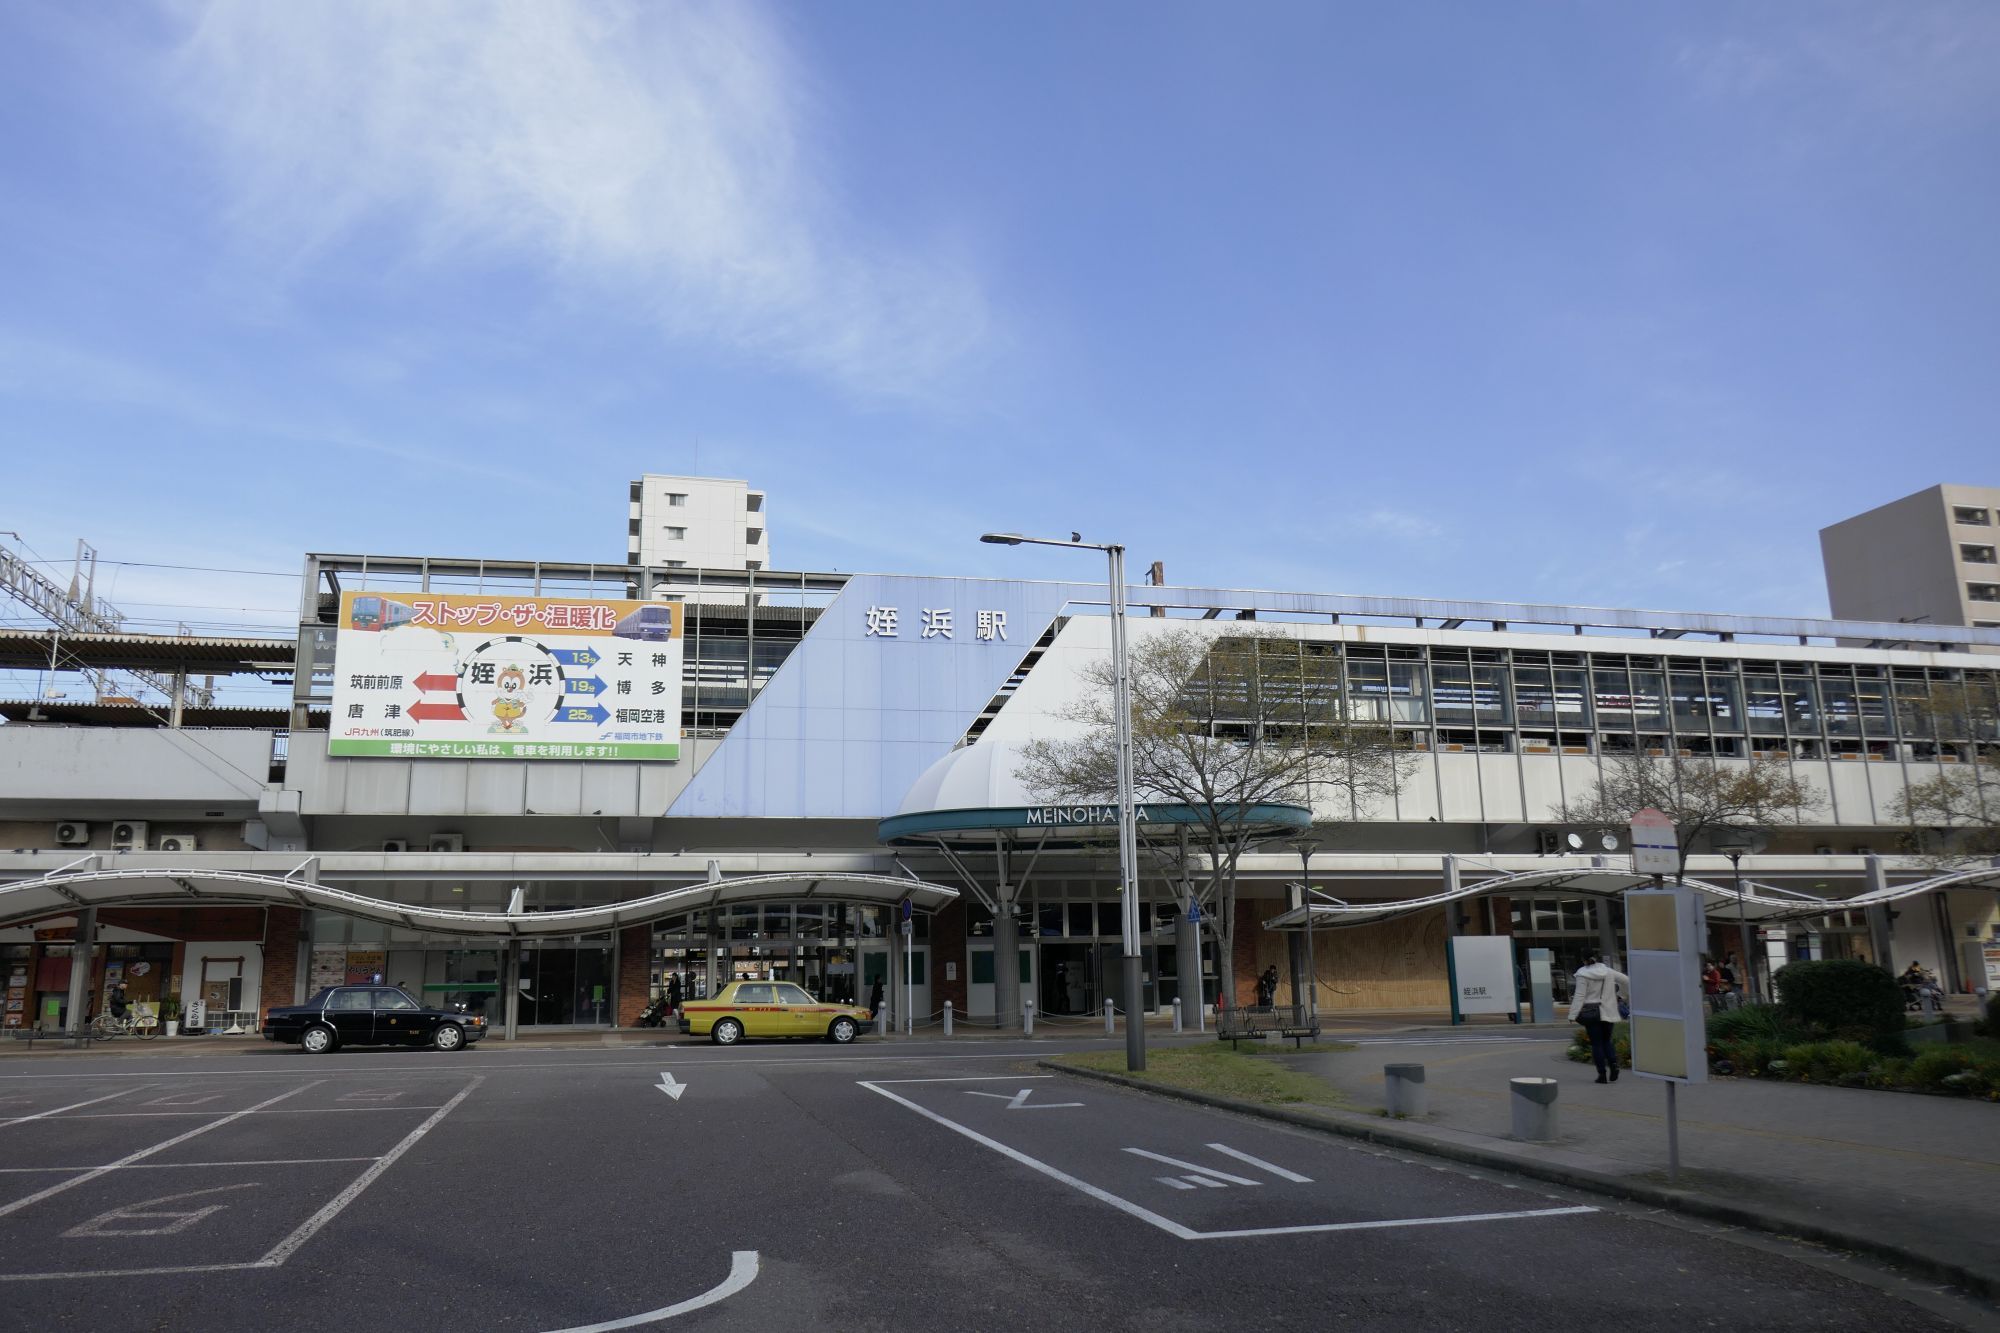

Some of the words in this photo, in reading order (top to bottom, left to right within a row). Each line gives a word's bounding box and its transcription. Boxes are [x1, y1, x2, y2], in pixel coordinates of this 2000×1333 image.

[411, 602, 617, 631] ストップ・ザ・温暖化
[866, 605, 1008, 641] 姪浜駅
[350, 674, 403, 690] 筑前前原
[616, 708, 666, 724] 福岡空港
[614, 732, 664, 741] 福岡市地下鉄
[1026, 805, 1150, 824] MEINOHAA
